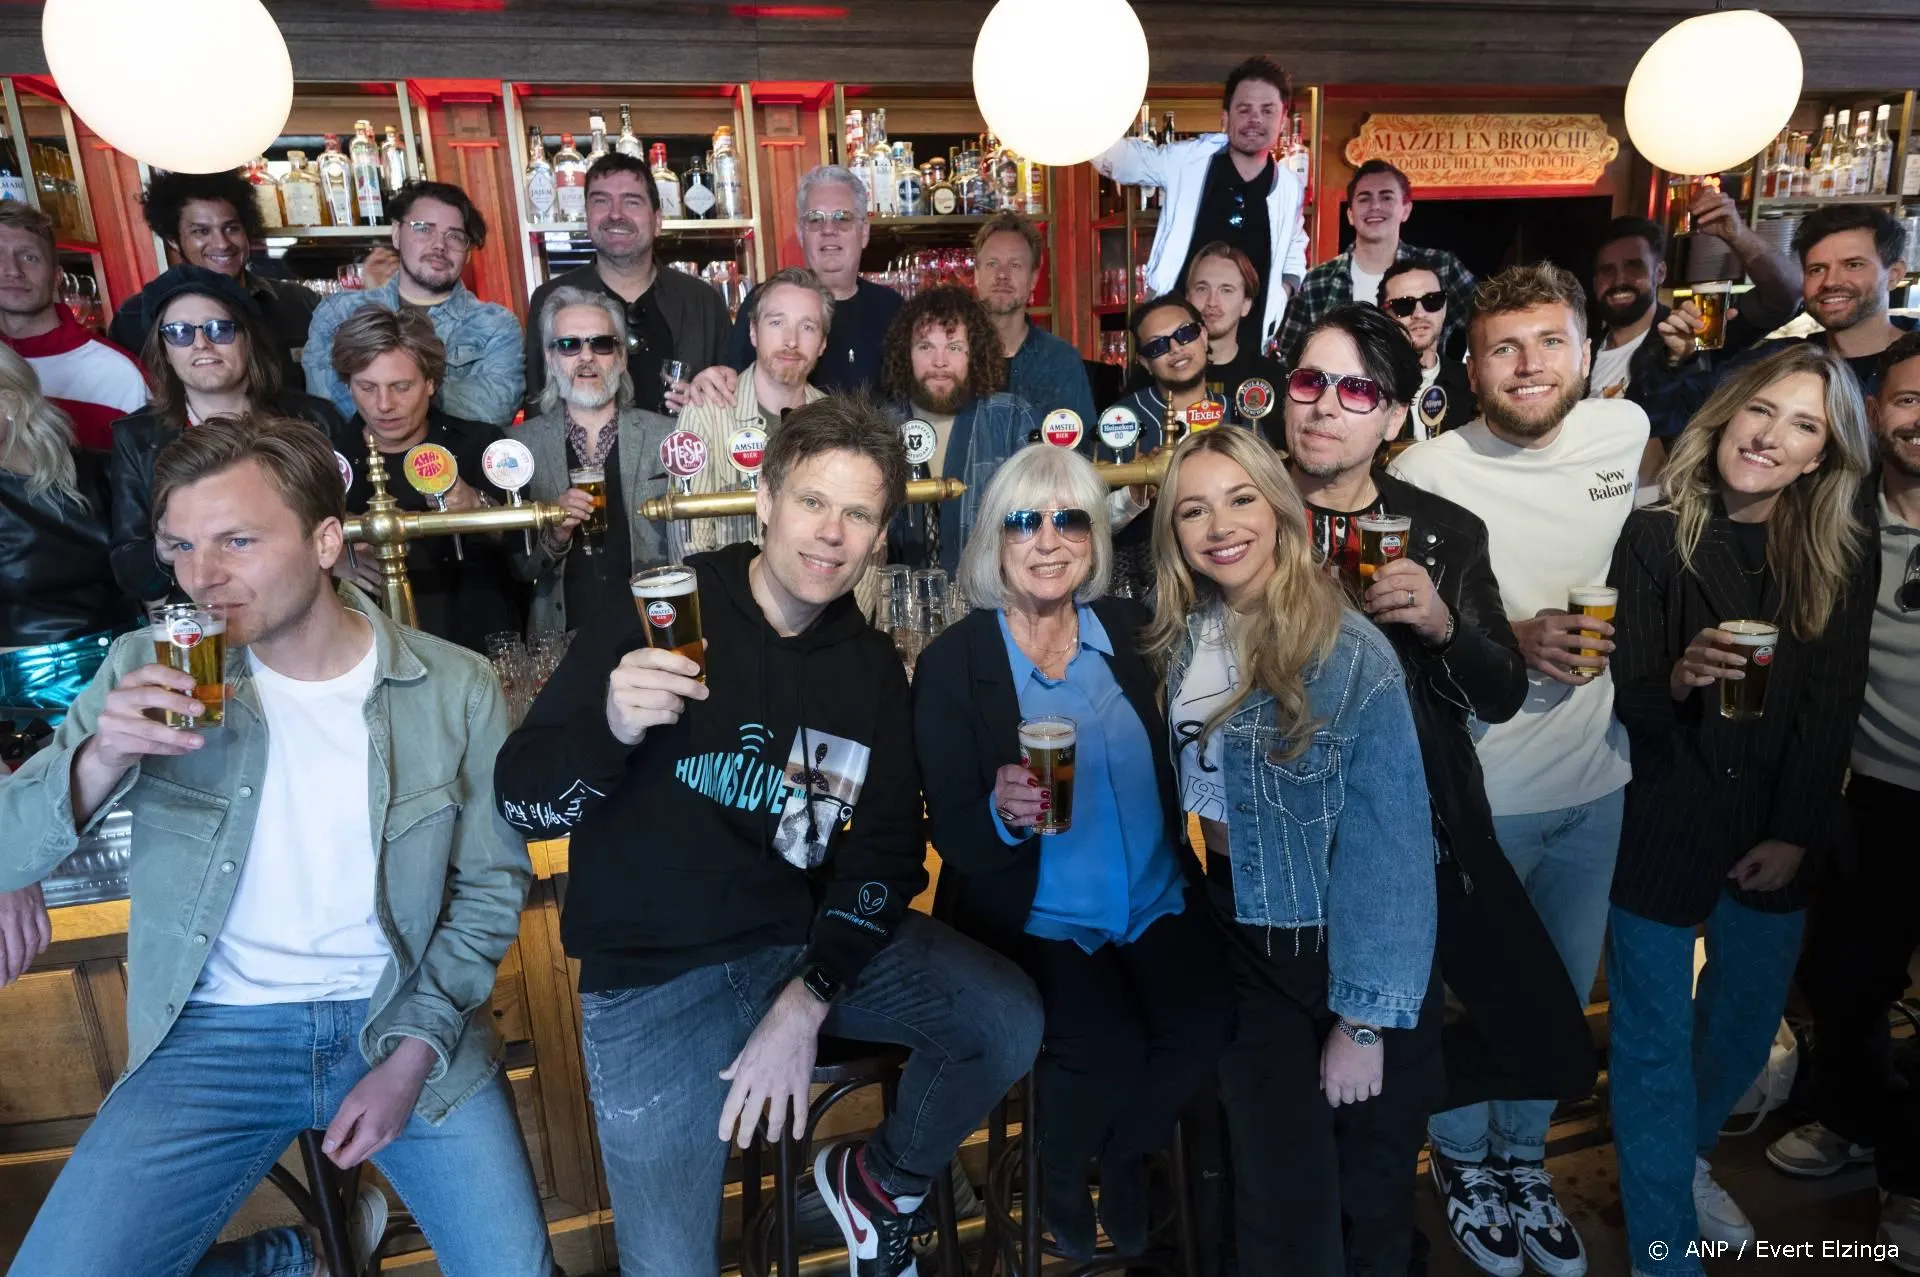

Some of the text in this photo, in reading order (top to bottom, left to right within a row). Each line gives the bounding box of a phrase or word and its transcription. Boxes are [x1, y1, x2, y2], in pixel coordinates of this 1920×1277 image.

[1375, 131, 1593, 151] MAZZEL EN BROOCHE
[1390, 157, 1429, 169] VOOR
[1432, 157, 1450, 168] DE
[1454, 156, 1490, 168] HELE
[1188, 409, 1221, 421] TEXELS
[1049, 423, 1076, 431] AMSTEL
[1103, 424, 1135, 432] Heineken
[1595, 469, 1625, 484] New
[675, 752, 788, 814] HUMANS LOVE
